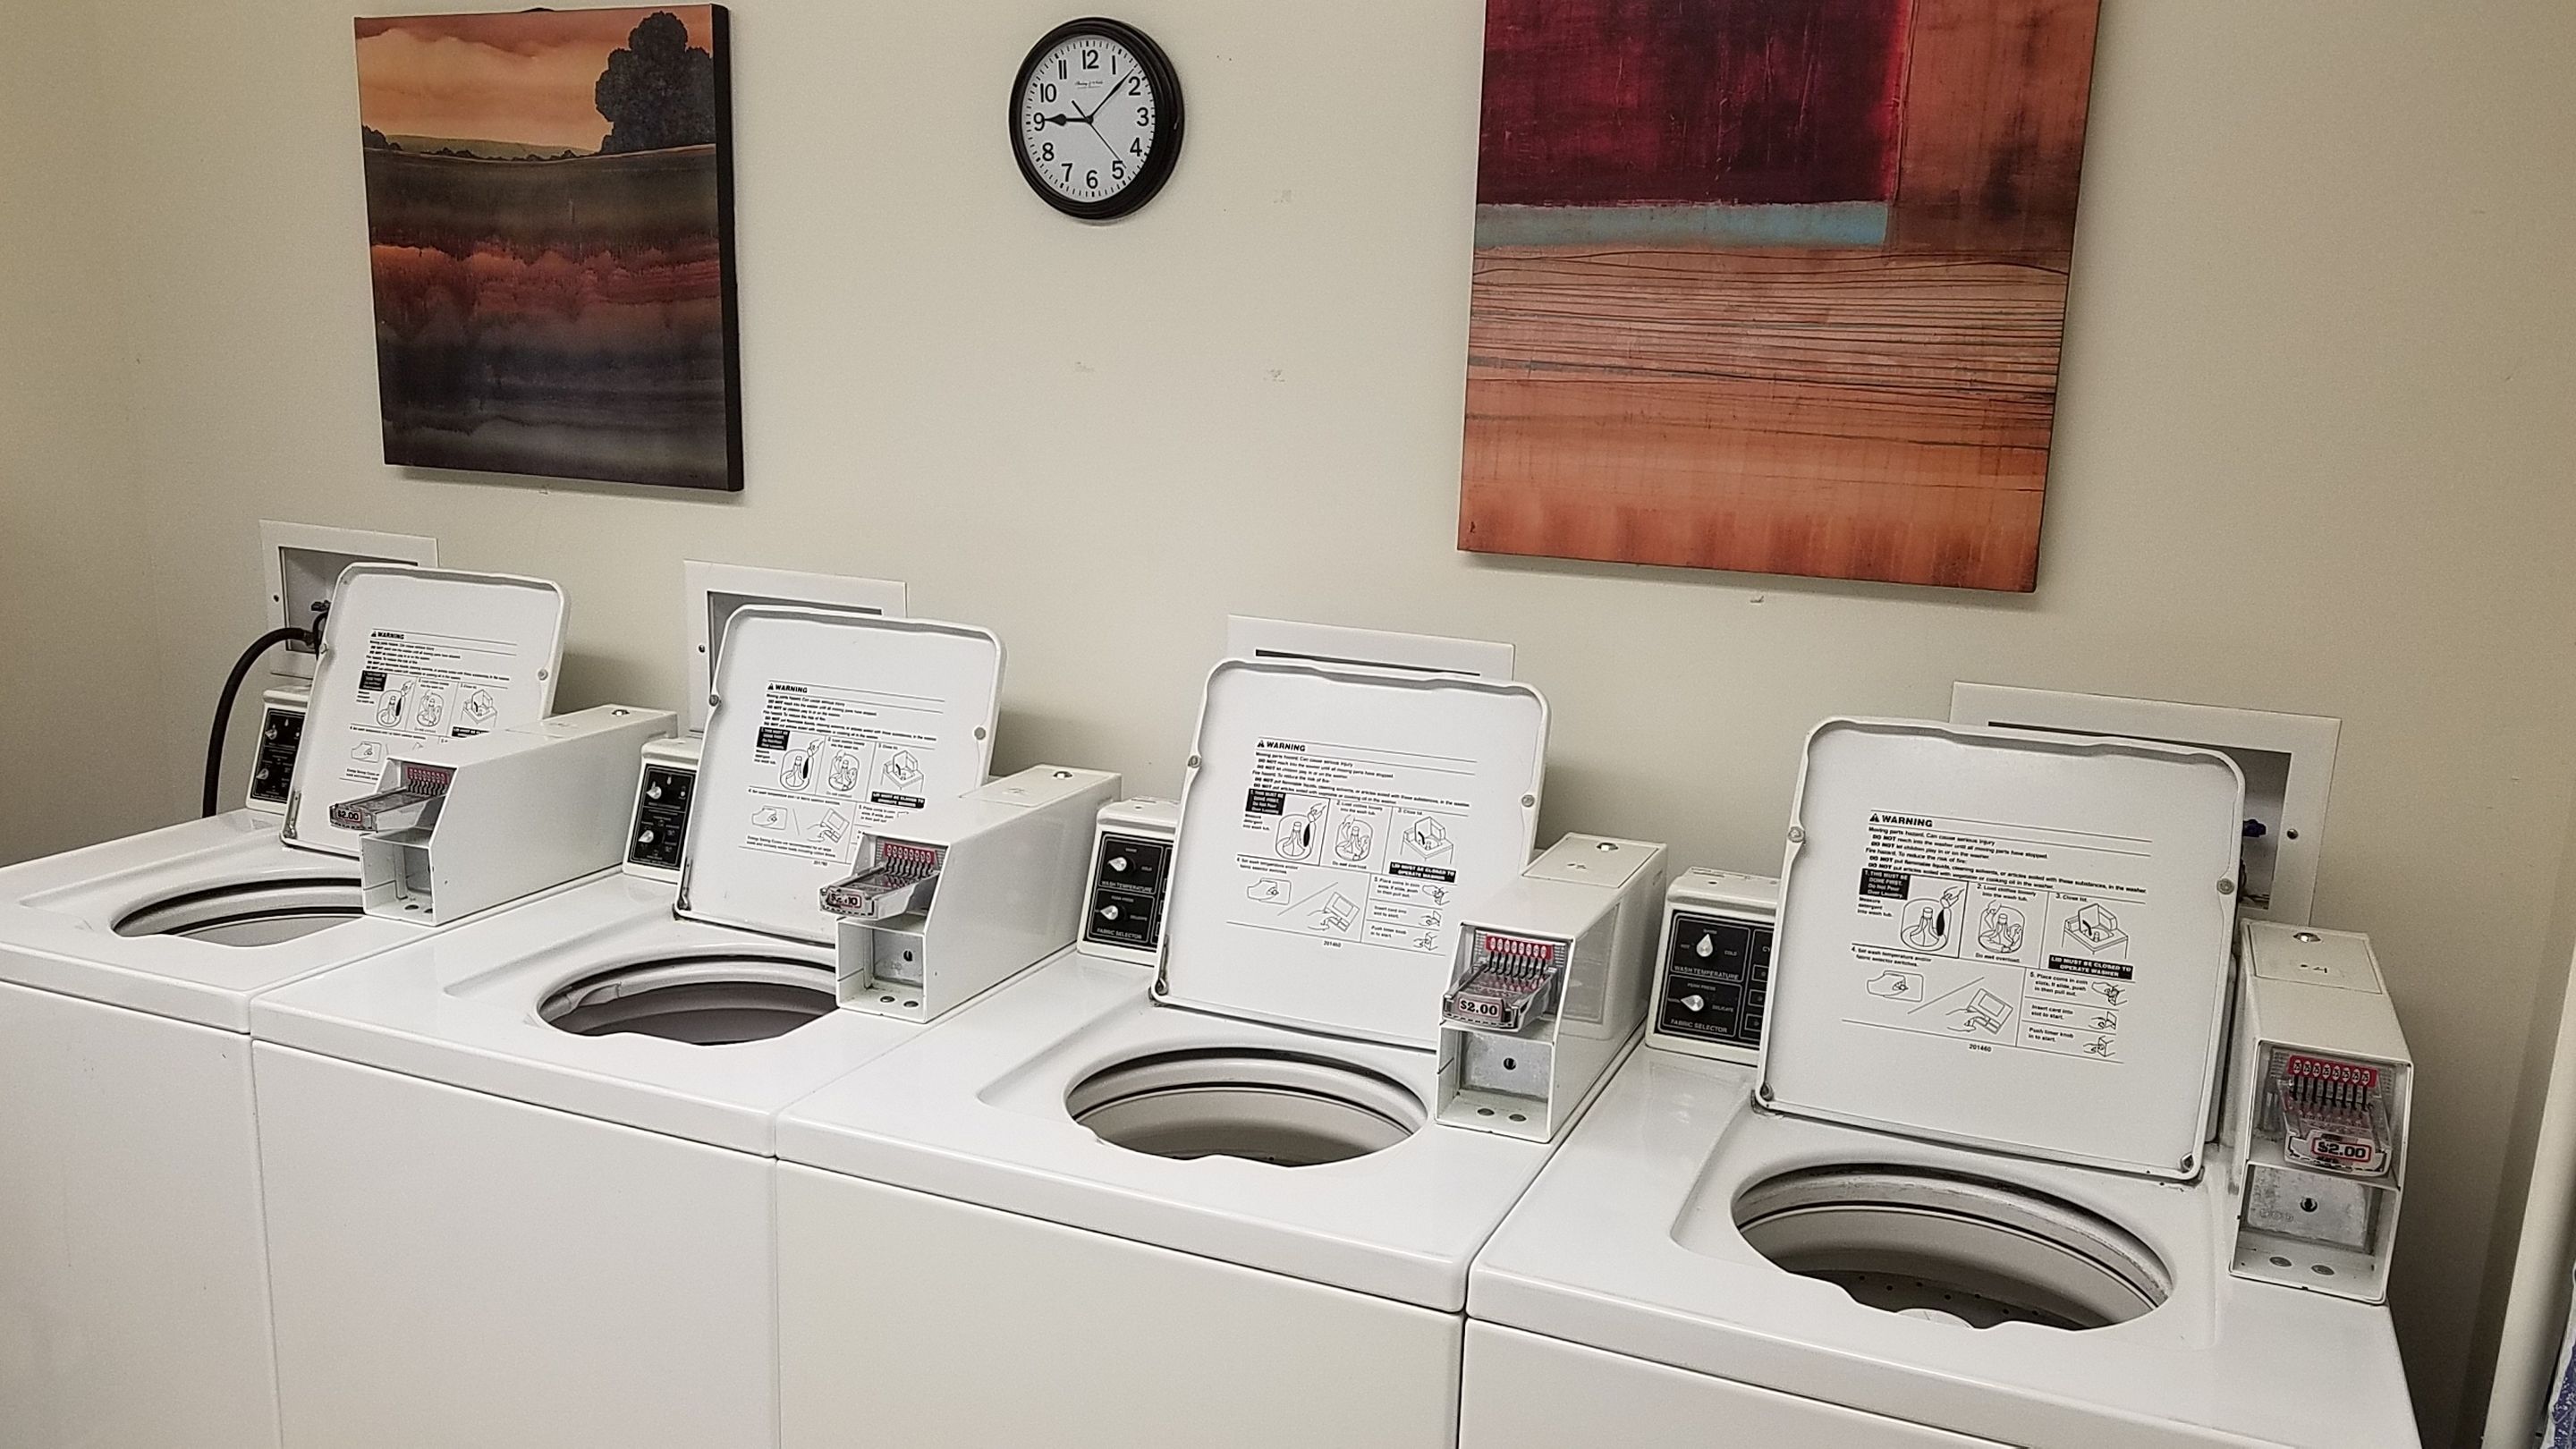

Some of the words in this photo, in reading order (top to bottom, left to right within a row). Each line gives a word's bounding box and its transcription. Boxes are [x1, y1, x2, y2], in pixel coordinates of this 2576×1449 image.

[1083, 50, 1099, 69] 12
[1112, 55, 1116, 75] 1
[1058, 60, 1067, 79] 11
[1040, 83, 1057, 102] 10
[1128, 76, 1141, 96] 2
[1033, 112, 1045, 131] 9
[1137, 107, 1149, 126] 3
[1042, 143, 1054, 161] 8
[1130, 138, 1142, 157] 4
[1062, 163, 1073, 182] 7
[1086, 170, 1098, 189] 6
[1112, 161, 1124, 179] 5
[775, 684, 807, 693] WARNING
[1267, 741, 1306, 751] WARNING
[1882, 815, 1932, 827] WARNING
[1694, 968, 1739, 980] TEMPERATURE
[1460, 1000, 1497, 1015] $2.00
[1670, 1019, 1693, 1027] FABRIC
[1694, 1023, 1727, 1033] SELECTOR
[2317, 1142, 2366, 1158] $2.00
